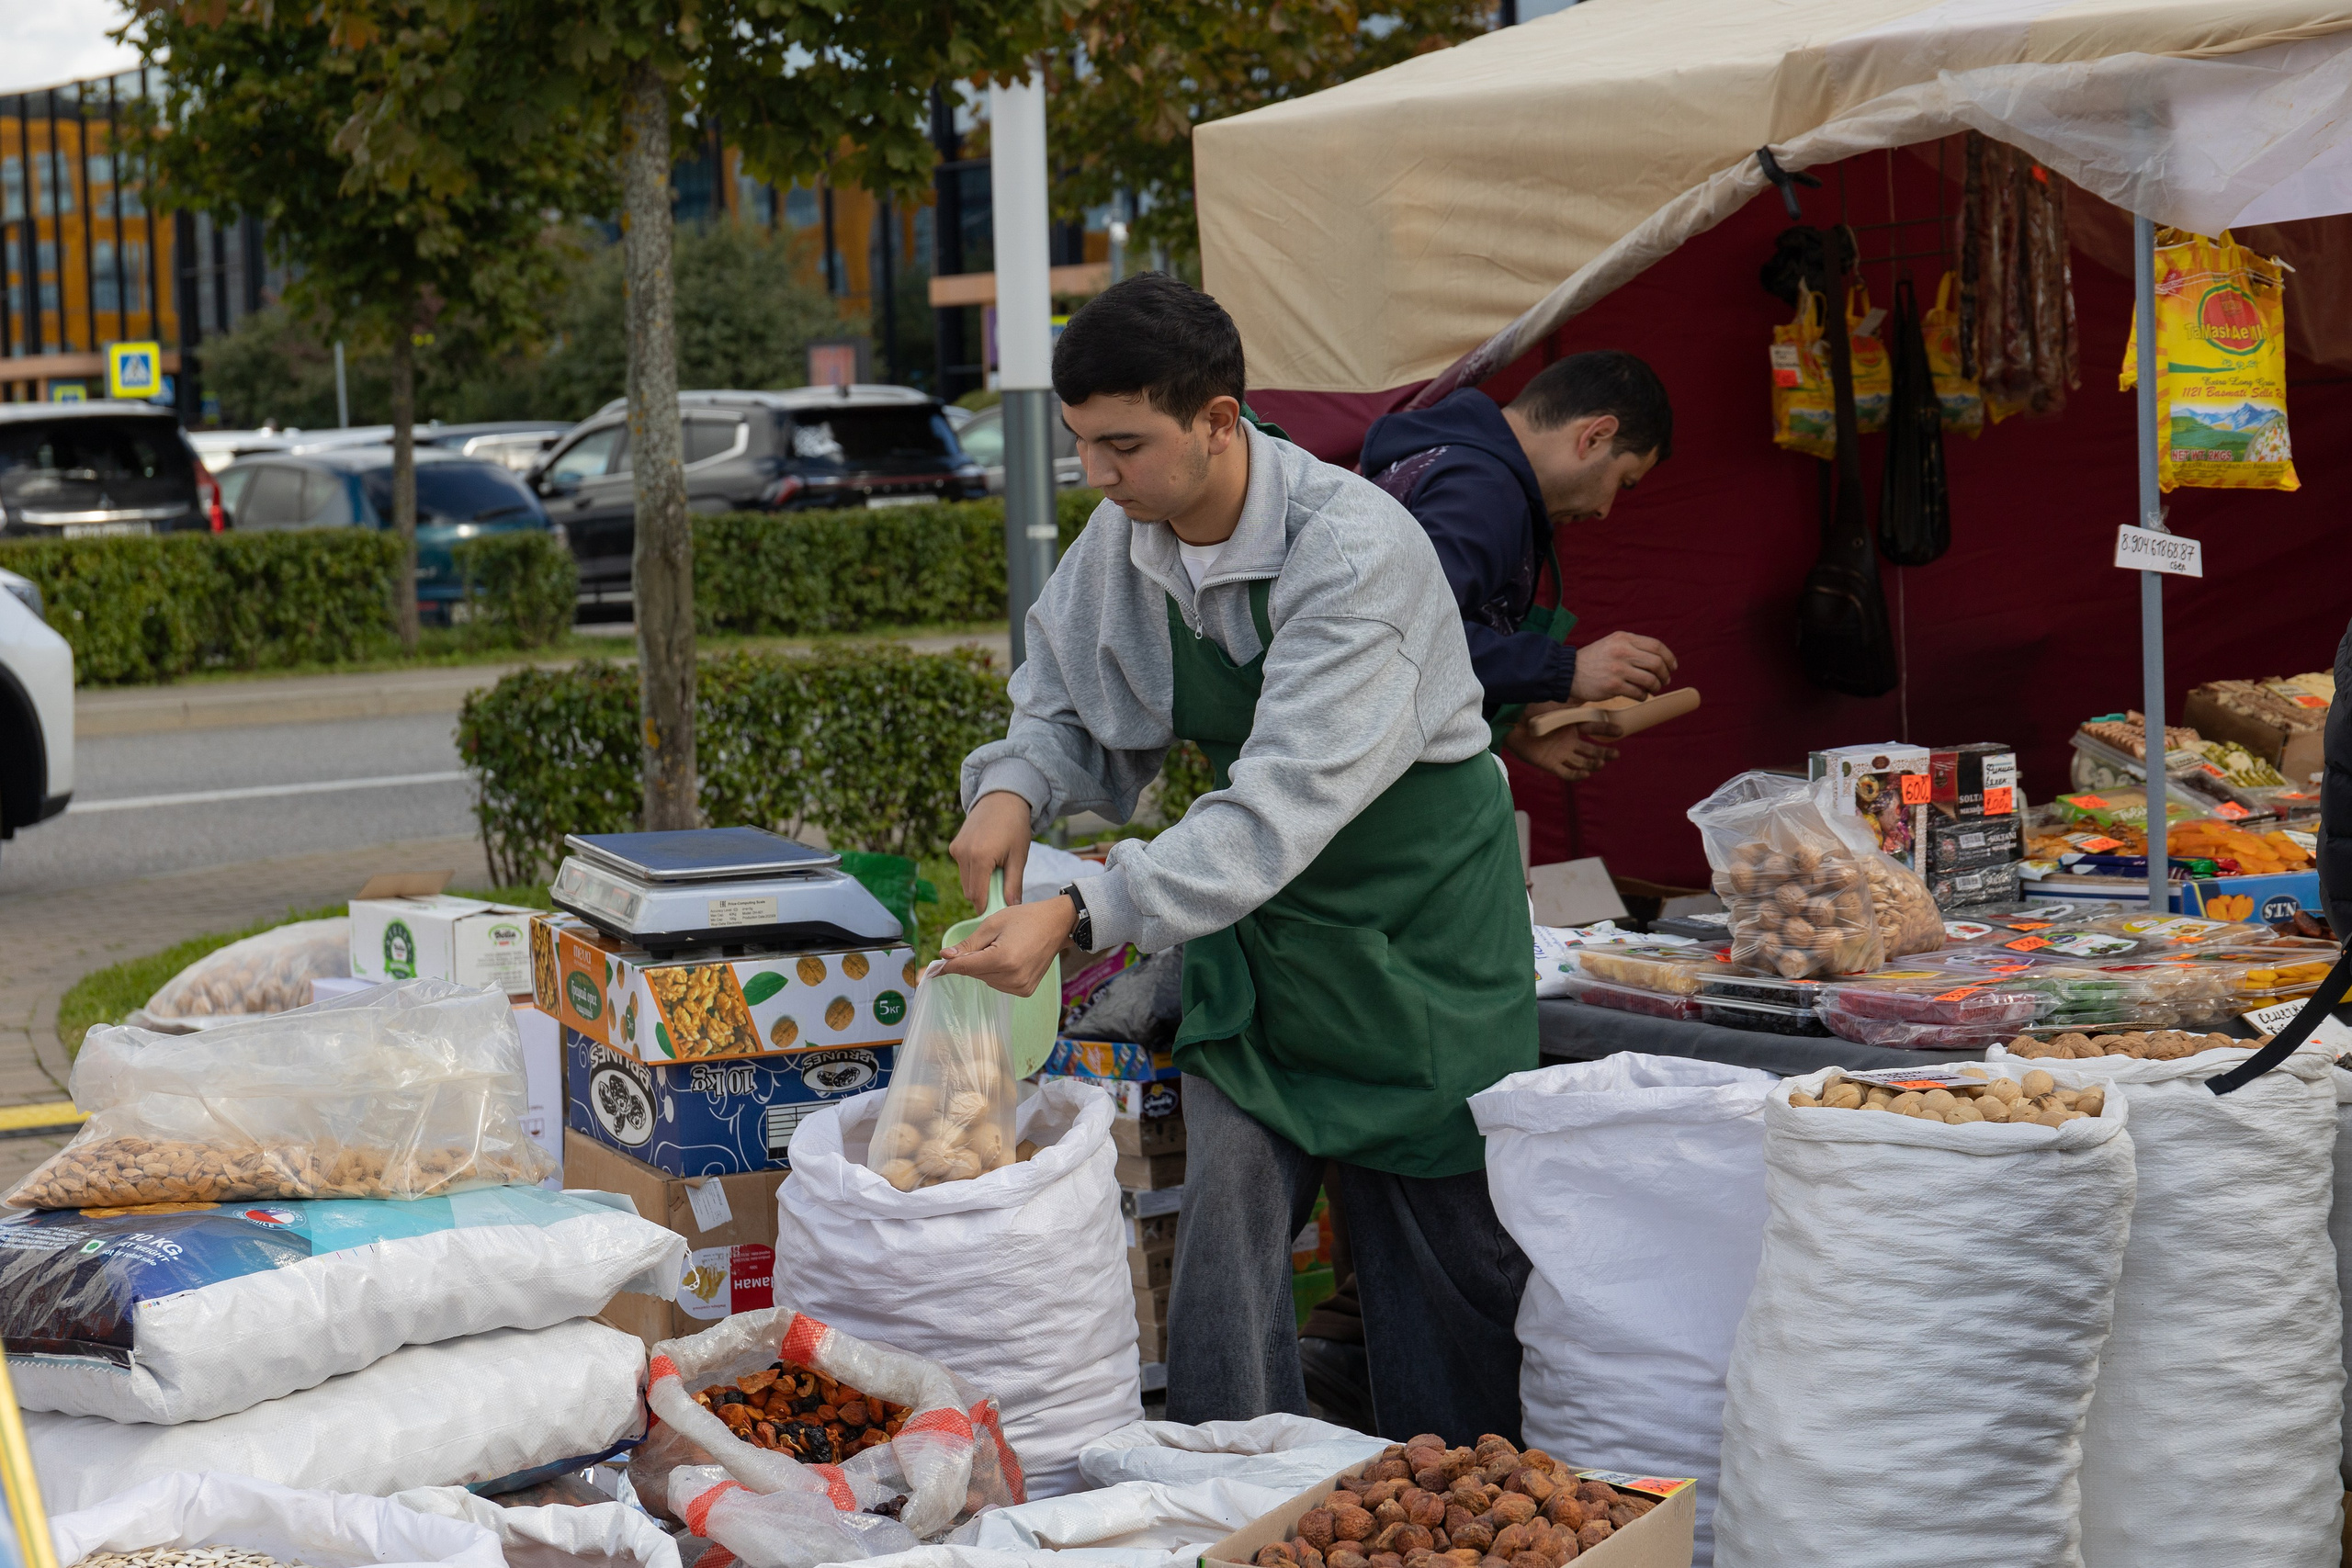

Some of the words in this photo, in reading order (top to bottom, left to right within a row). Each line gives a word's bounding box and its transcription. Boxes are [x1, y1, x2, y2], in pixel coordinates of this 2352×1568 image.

[2182, 387, 2203, 397] 1121
[2205, 386, 2247, 398] Basmati
[2171, 449, 2189, 461] NET
[803, 1049, 874, 1069] PRUNES
[726, 1066, 756, 1095] 10
[130, 1233, 154, 1242] 10
[134, 1243, 172, 1263] WEIGHT
